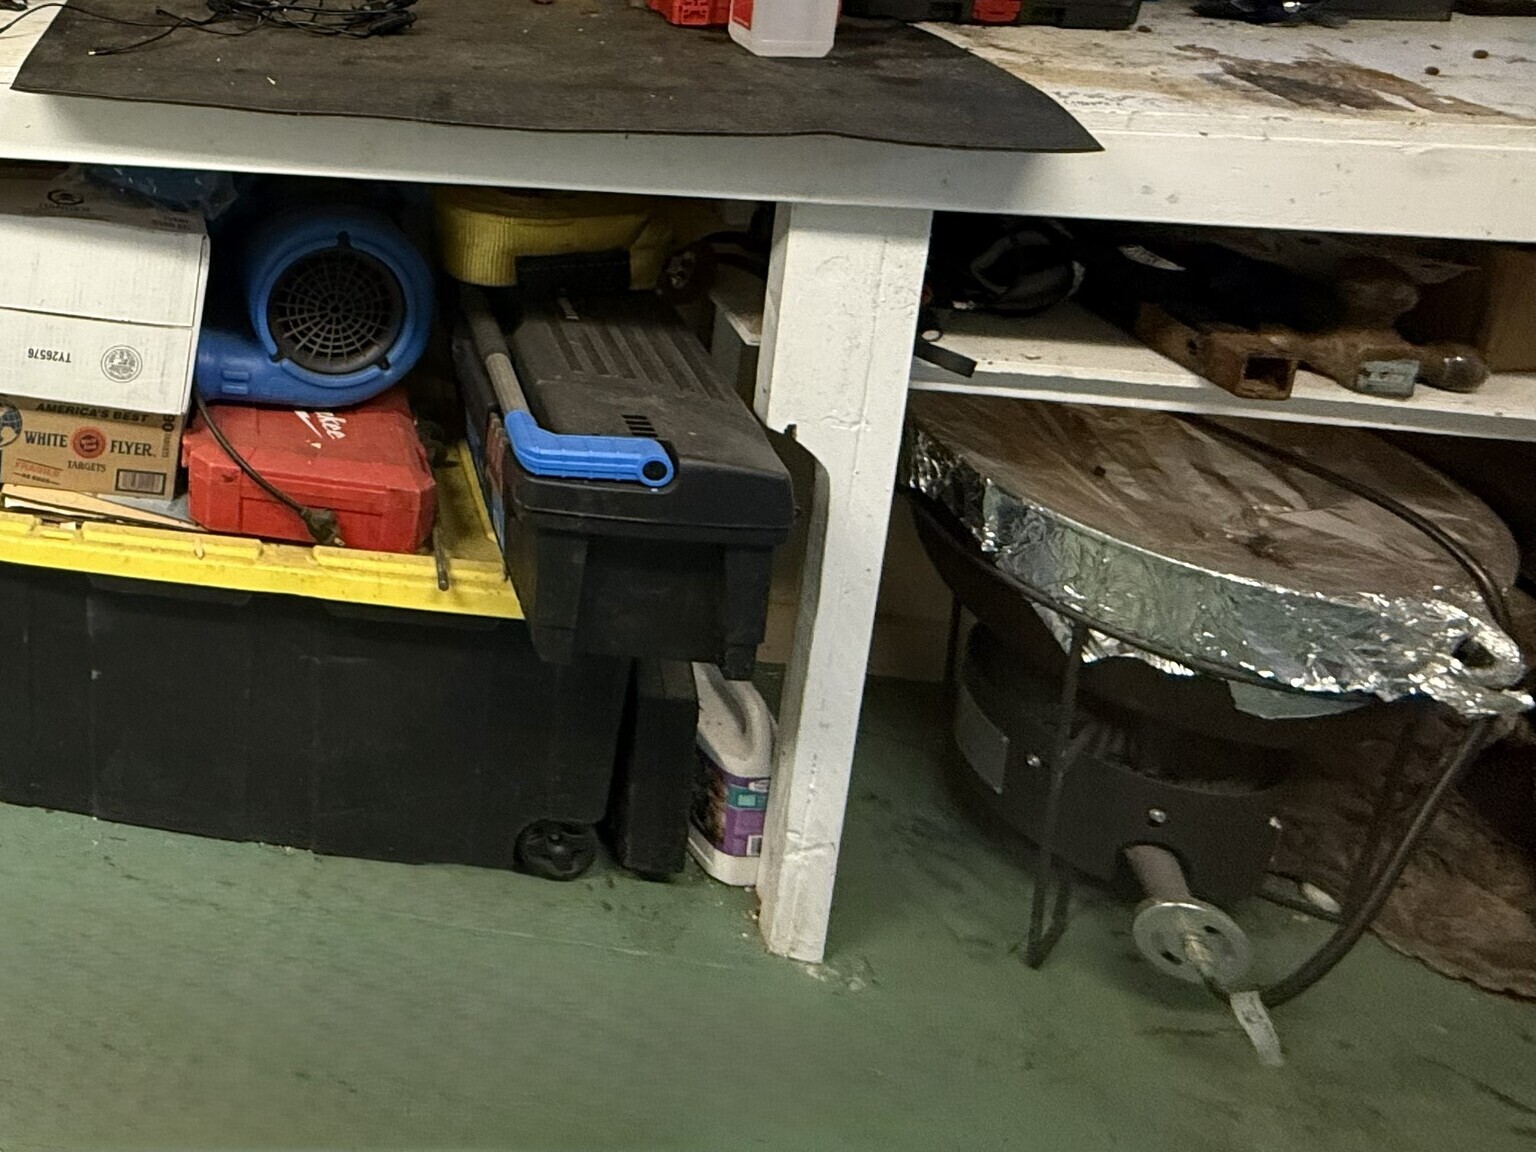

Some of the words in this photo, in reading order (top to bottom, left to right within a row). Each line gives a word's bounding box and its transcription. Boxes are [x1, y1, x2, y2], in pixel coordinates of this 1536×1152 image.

[27, 347, 72, 363] TY26576
[35, 402, 110, 419] AMERICA'S
[113, 411, 150, 423] BEST
[24, 430, 68, 448] WHITE
[109, 440, 153, 457] FLYER
[67, 460, 107, 473] TARGETS
